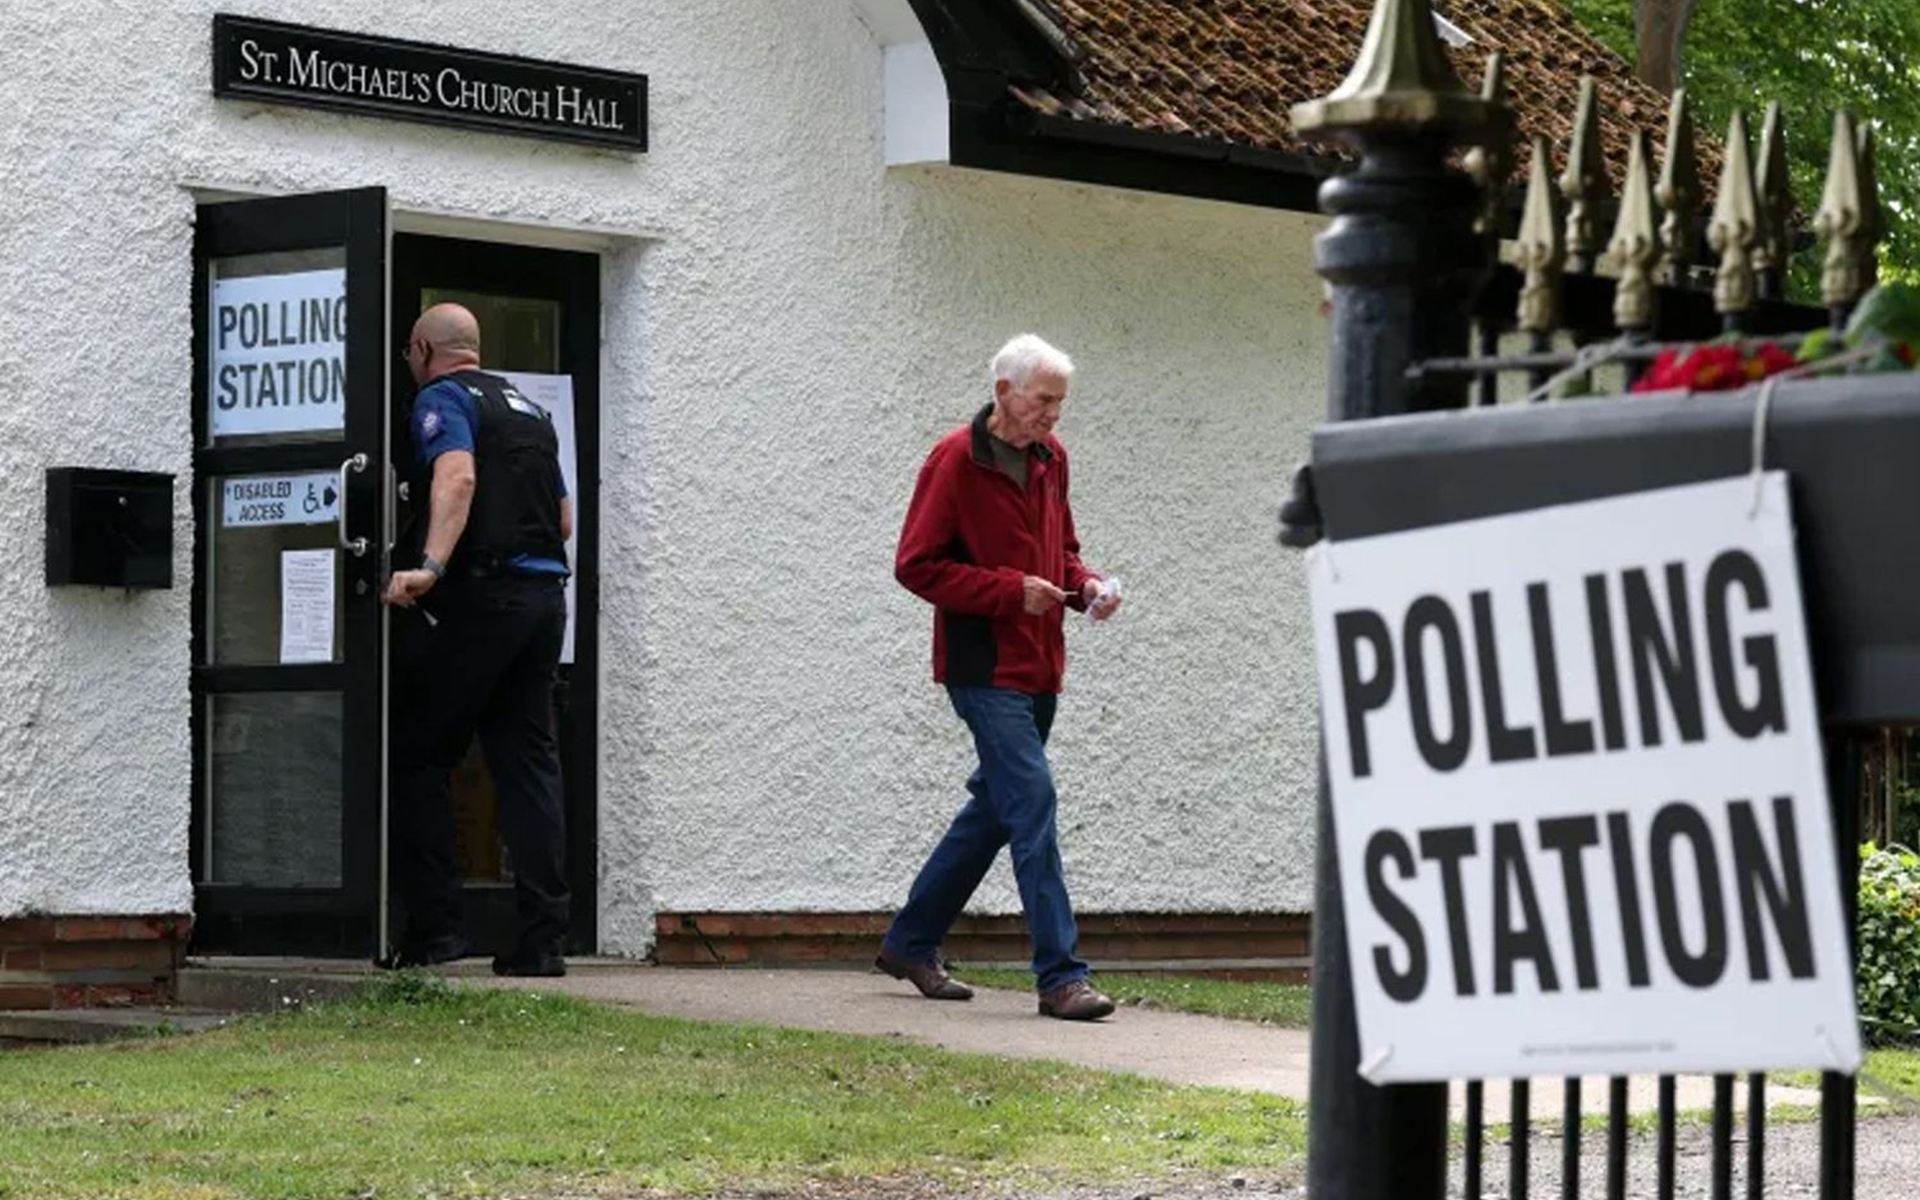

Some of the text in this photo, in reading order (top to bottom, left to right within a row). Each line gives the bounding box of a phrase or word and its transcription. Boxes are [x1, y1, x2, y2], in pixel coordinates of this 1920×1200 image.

[233, 481, 292, 501] DISABLED
[239, 502, 285, 522] ACCESS
[1334, 549, 1787, 779] POLLING
[1364, 796, 1817, 1003] STATION
